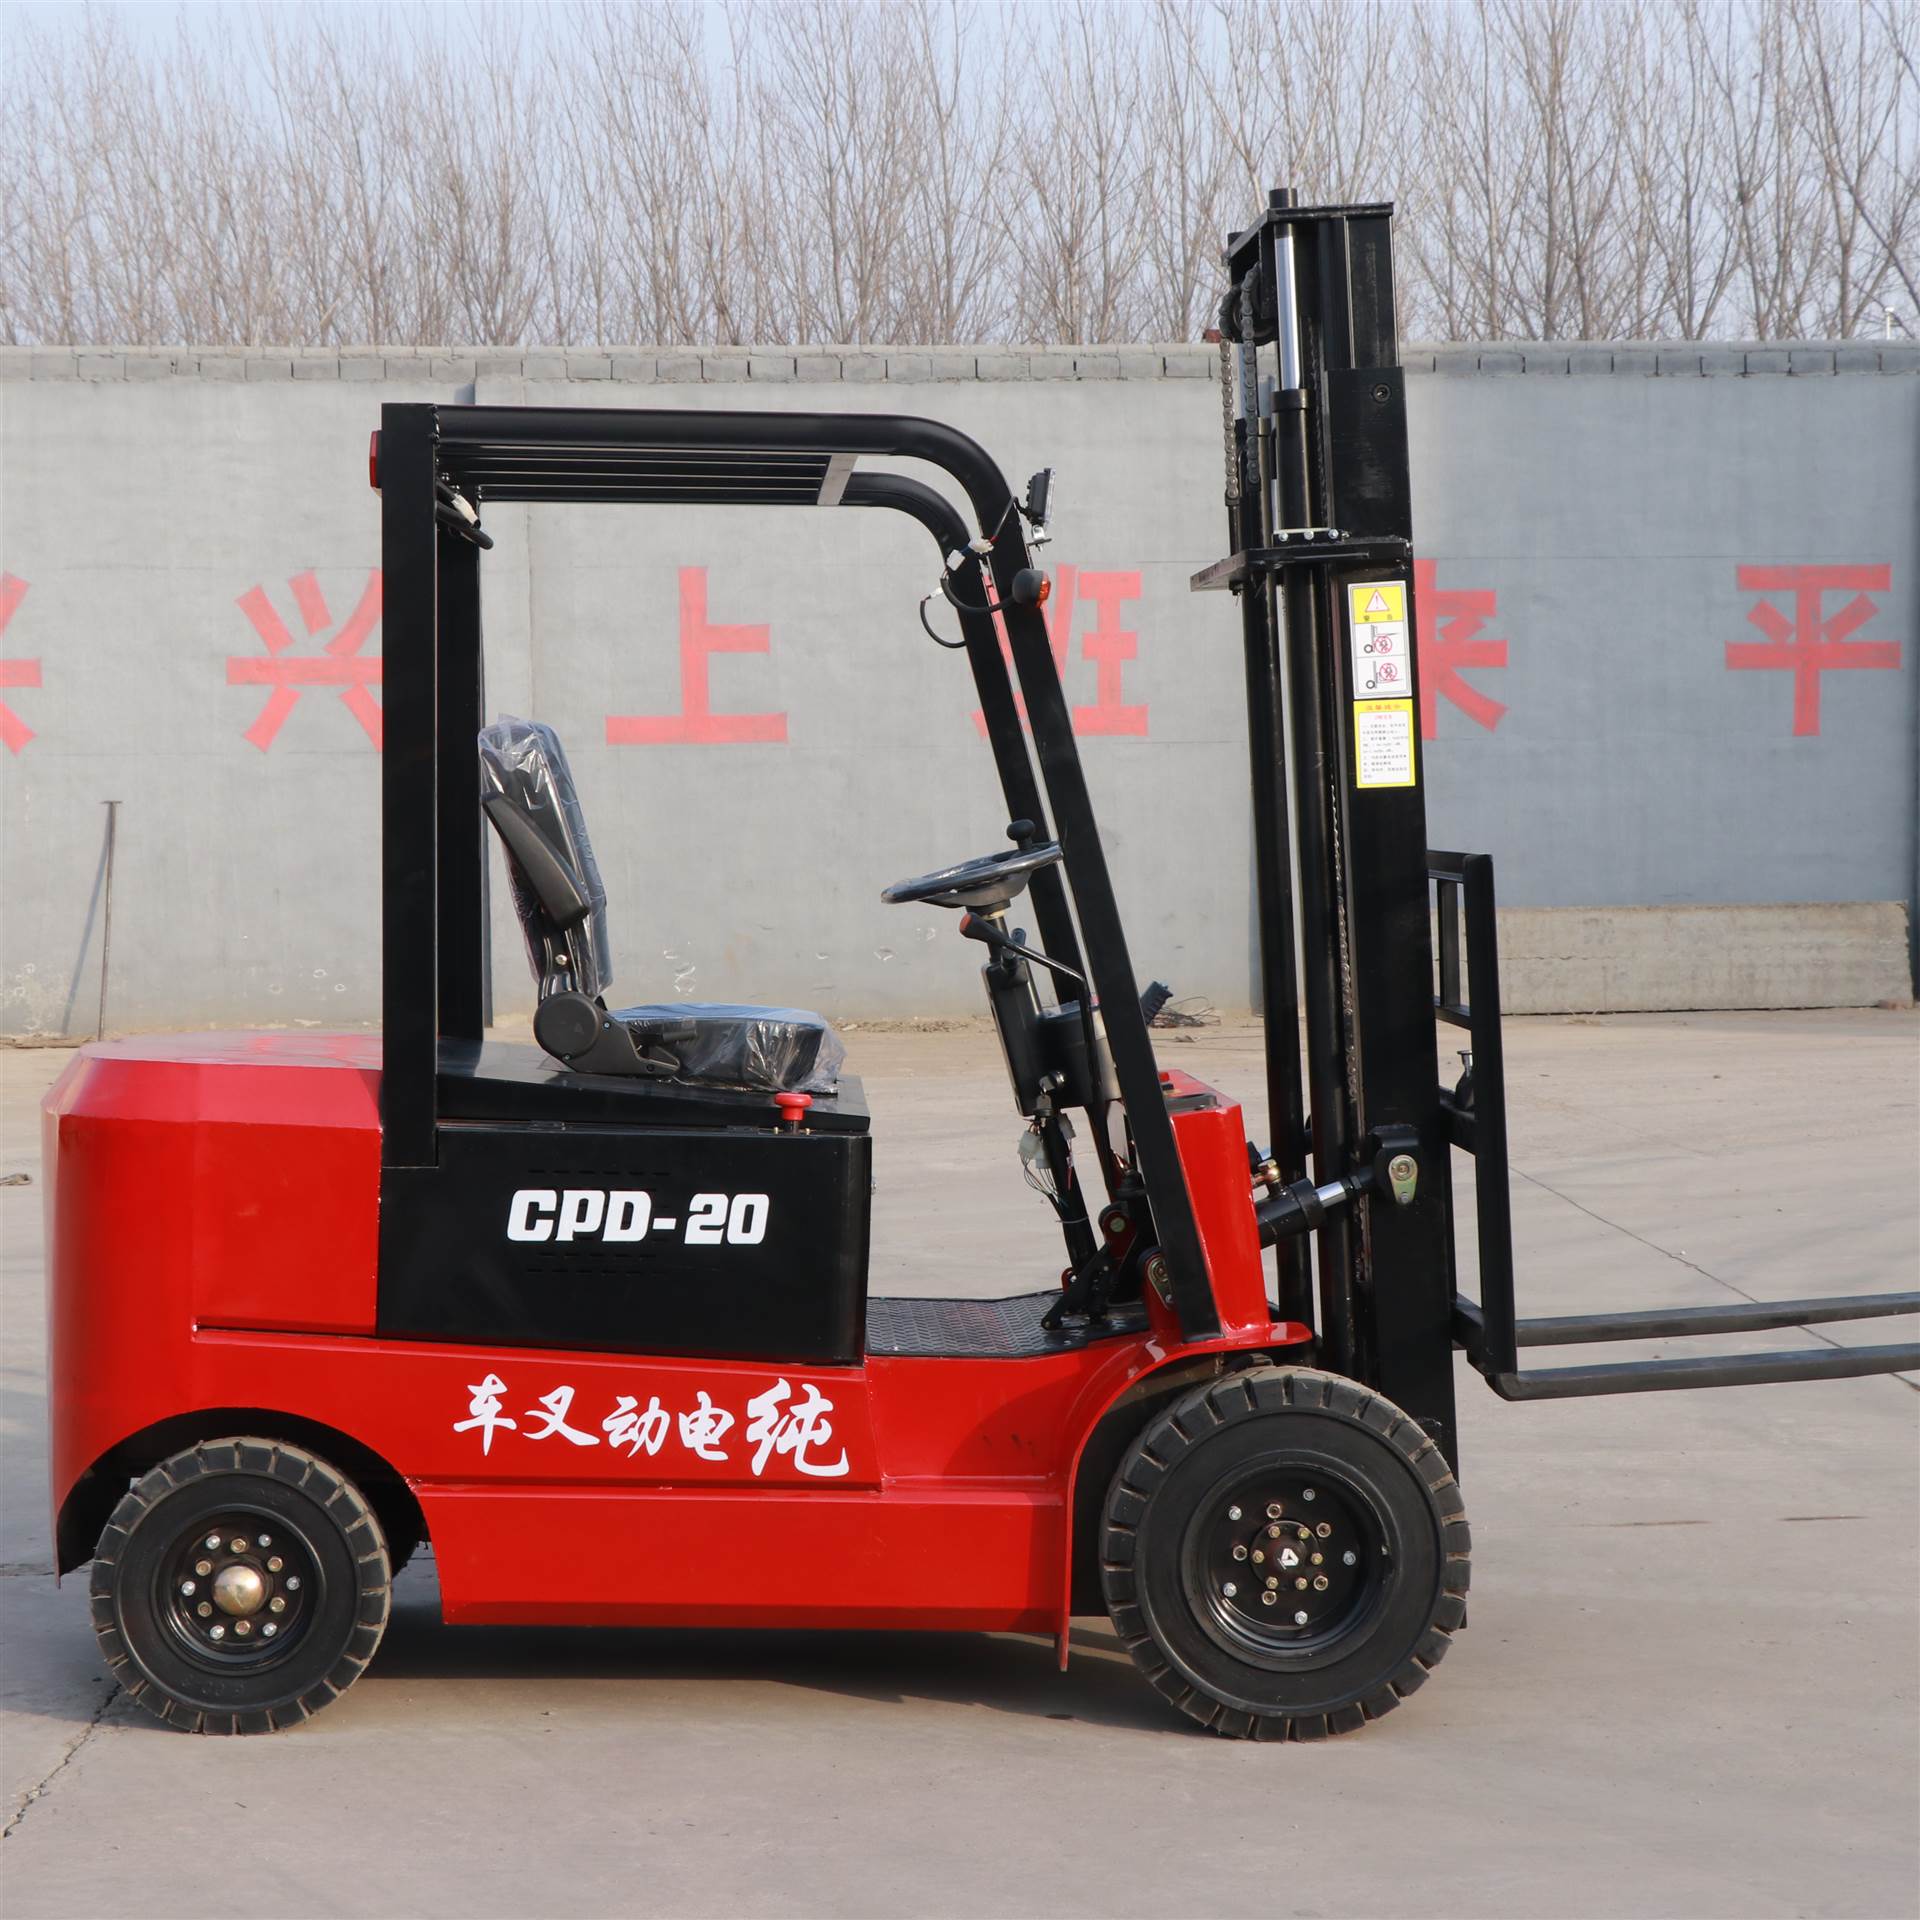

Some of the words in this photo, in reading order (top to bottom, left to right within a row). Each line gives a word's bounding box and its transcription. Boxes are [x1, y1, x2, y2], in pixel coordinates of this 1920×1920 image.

[605, 565, 788, 746] 上
[1724, 563, 1902, 737] 平
[506, 1188, 770, 1246] CPD-20
